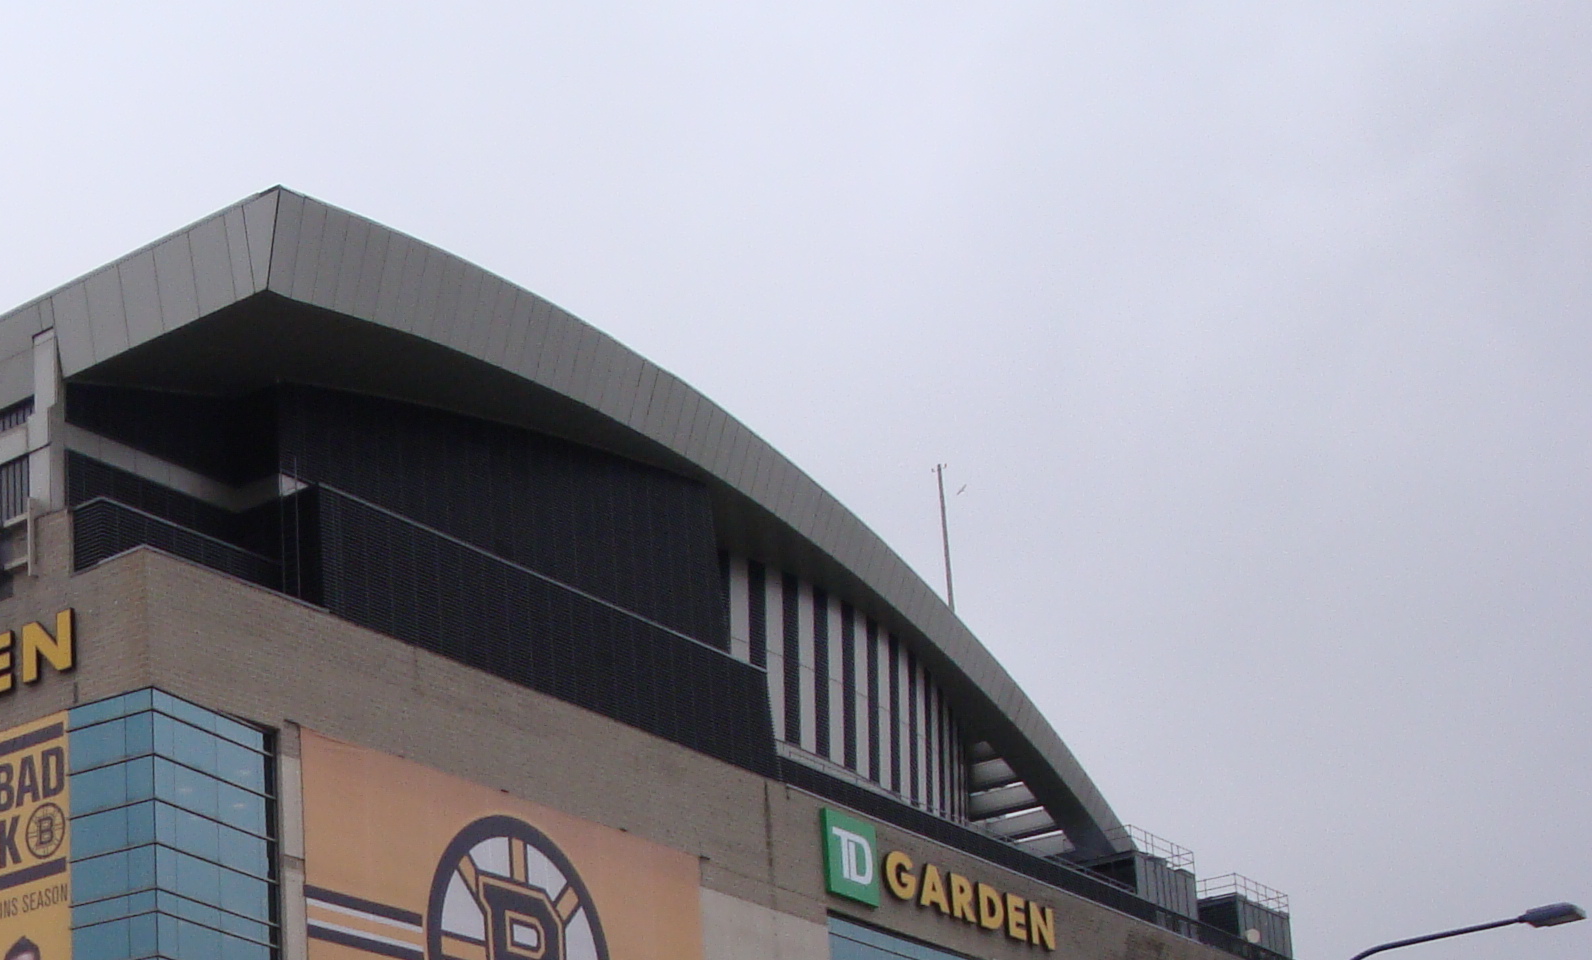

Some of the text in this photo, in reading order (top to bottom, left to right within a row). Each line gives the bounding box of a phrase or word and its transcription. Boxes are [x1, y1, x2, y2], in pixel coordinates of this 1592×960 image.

[21, 884, 69, 914] SEASON
[831, 825, 1056, 951] TD GARDEN
